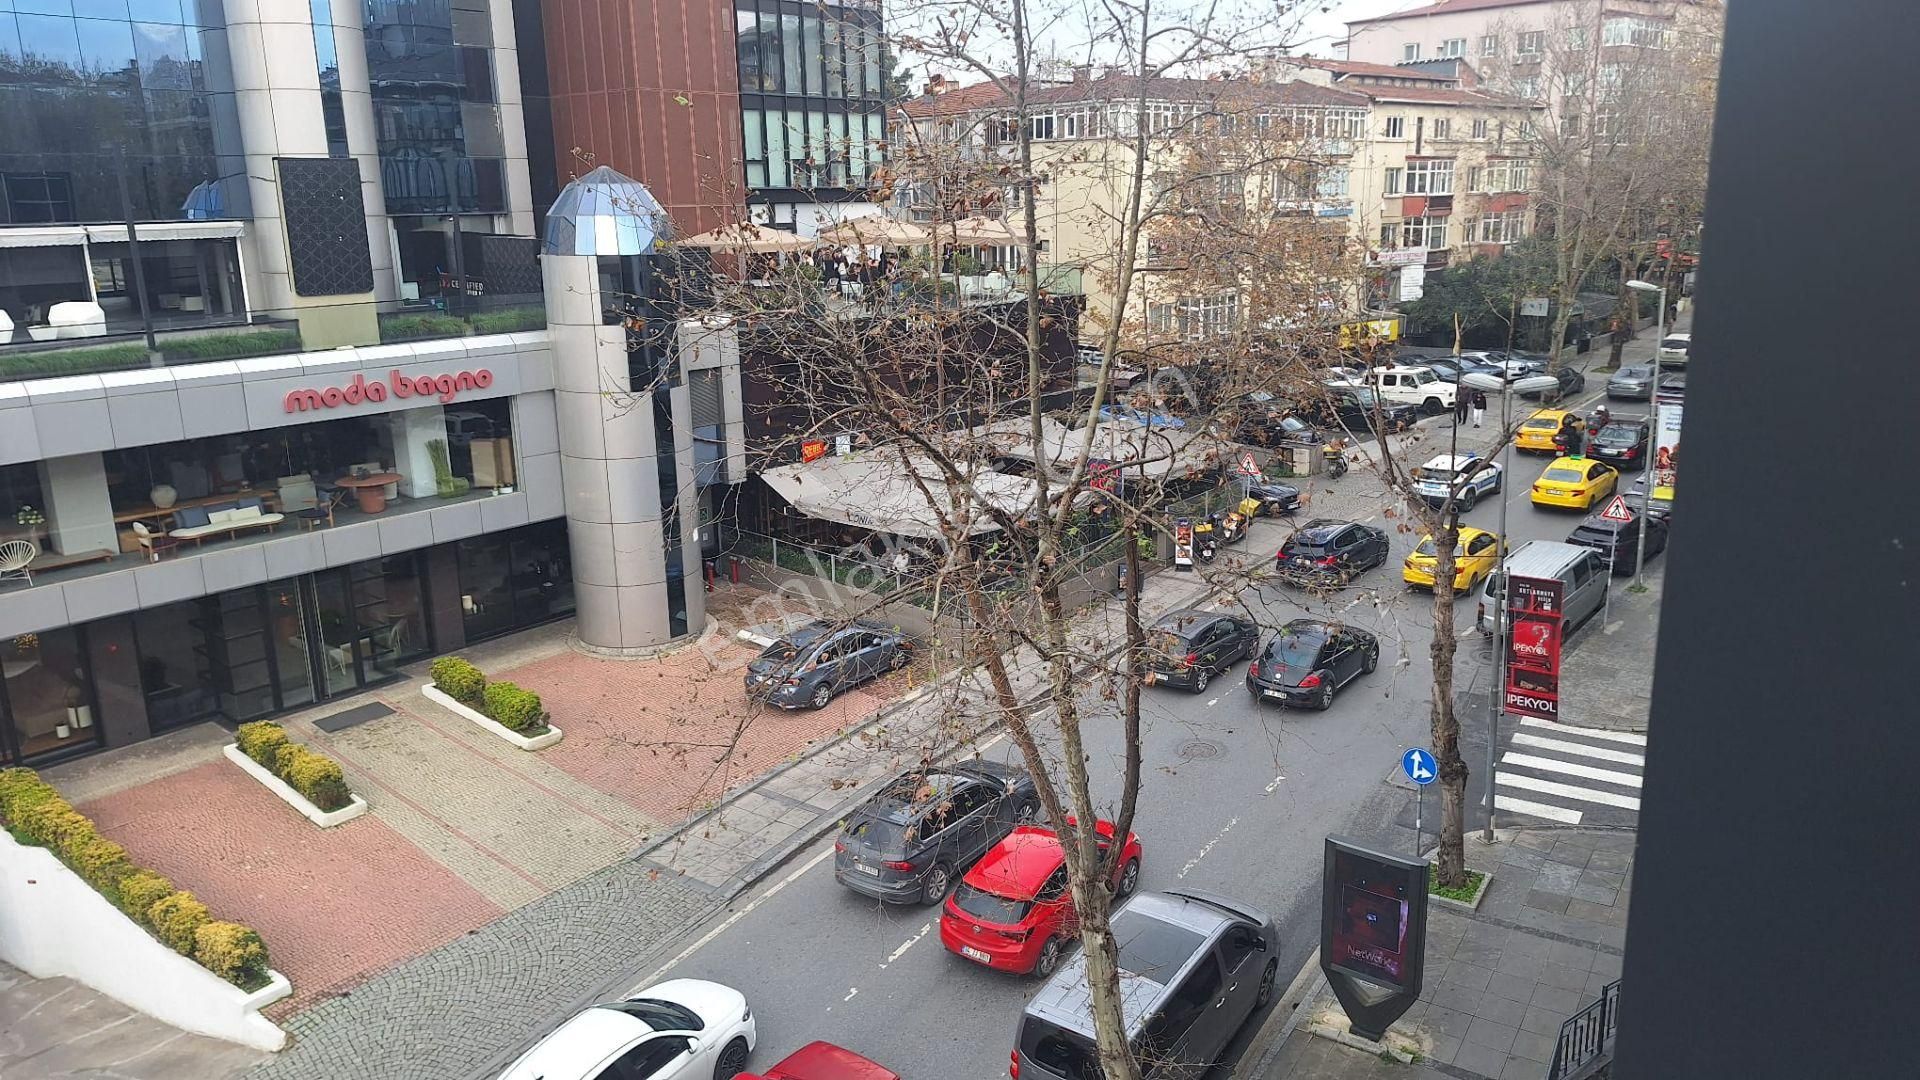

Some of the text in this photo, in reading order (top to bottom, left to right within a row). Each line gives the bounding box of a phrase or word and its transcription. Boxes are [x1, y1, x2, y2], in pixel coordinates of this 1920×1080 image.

[451, 280, 484, 291] CEIFIED
[284, 369, 494, 413] moda bagno
[1507, 693, 1556, 713] IPEKYOL
